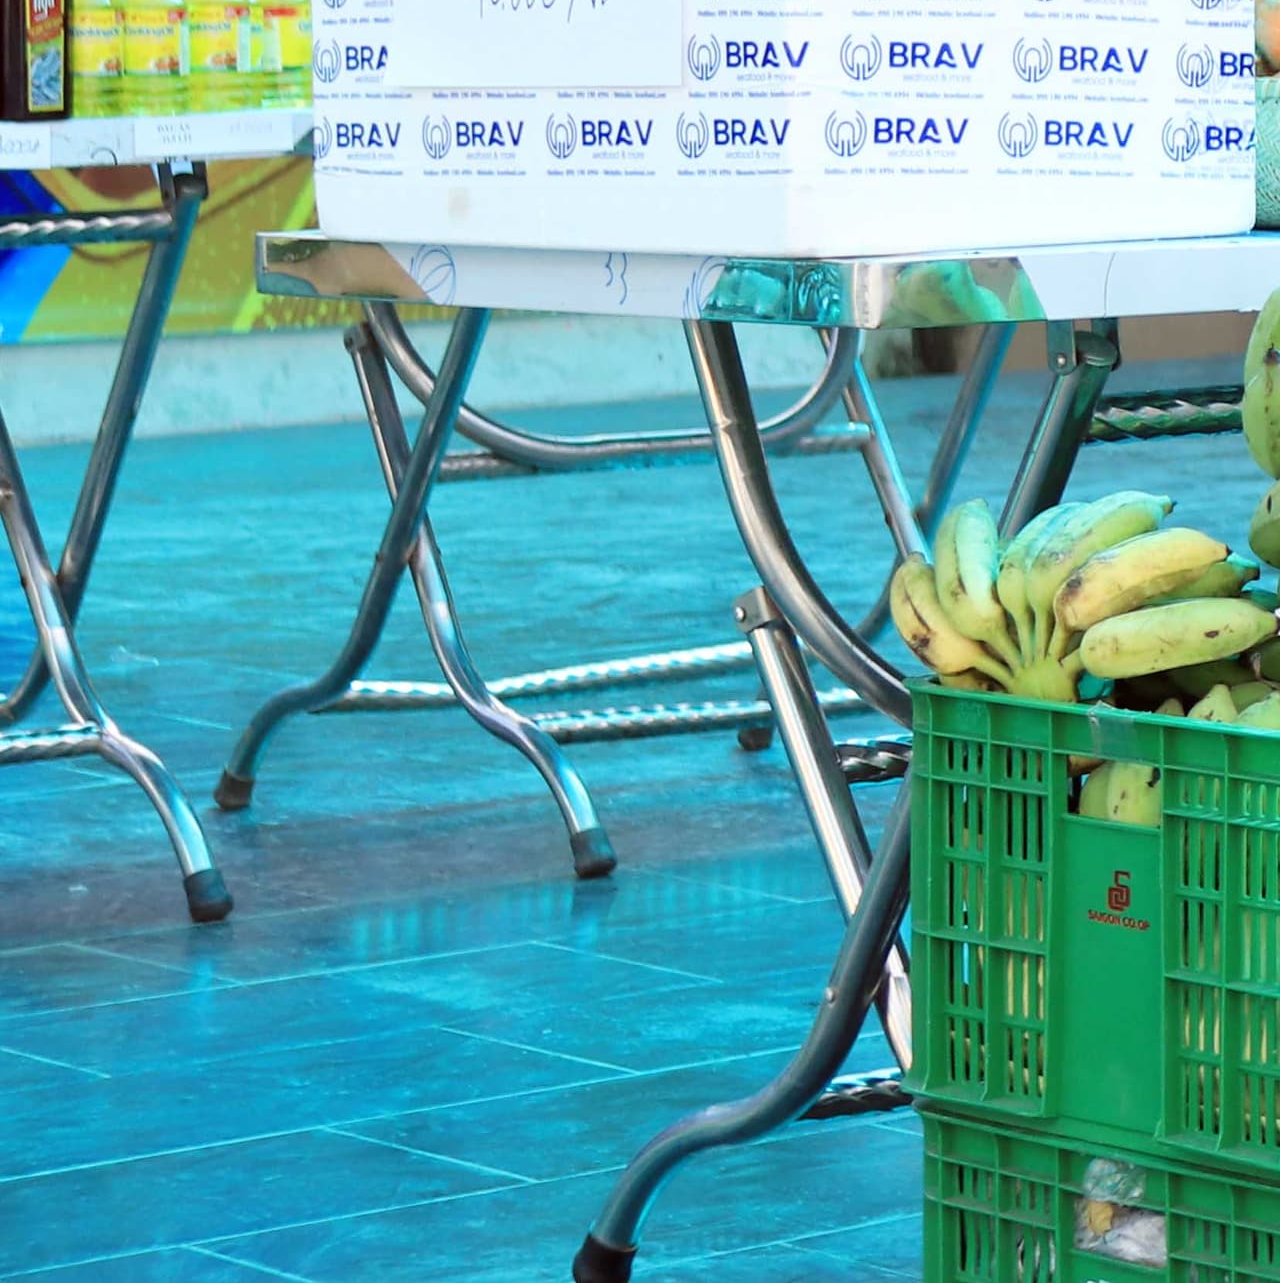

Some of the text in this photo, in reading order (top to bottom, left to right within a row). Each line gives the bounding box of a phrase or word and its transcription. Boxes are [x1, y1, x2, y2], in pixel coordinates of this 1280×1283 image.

[726, 42, 807, 67] BRAV
[890, 43, 982, 68] BRAV
[1060, 47, 1147, 73] BRAV
[337, 124, 400, 147] BRAV
[457, 122, 522, 146] BRAV
[582, 121, 652, 145] BRAV
[714, 120, 789, 145] BRAV
[875, 119, 967, 143] BRAV
[1045, 121, 1132, 147] BRAV
